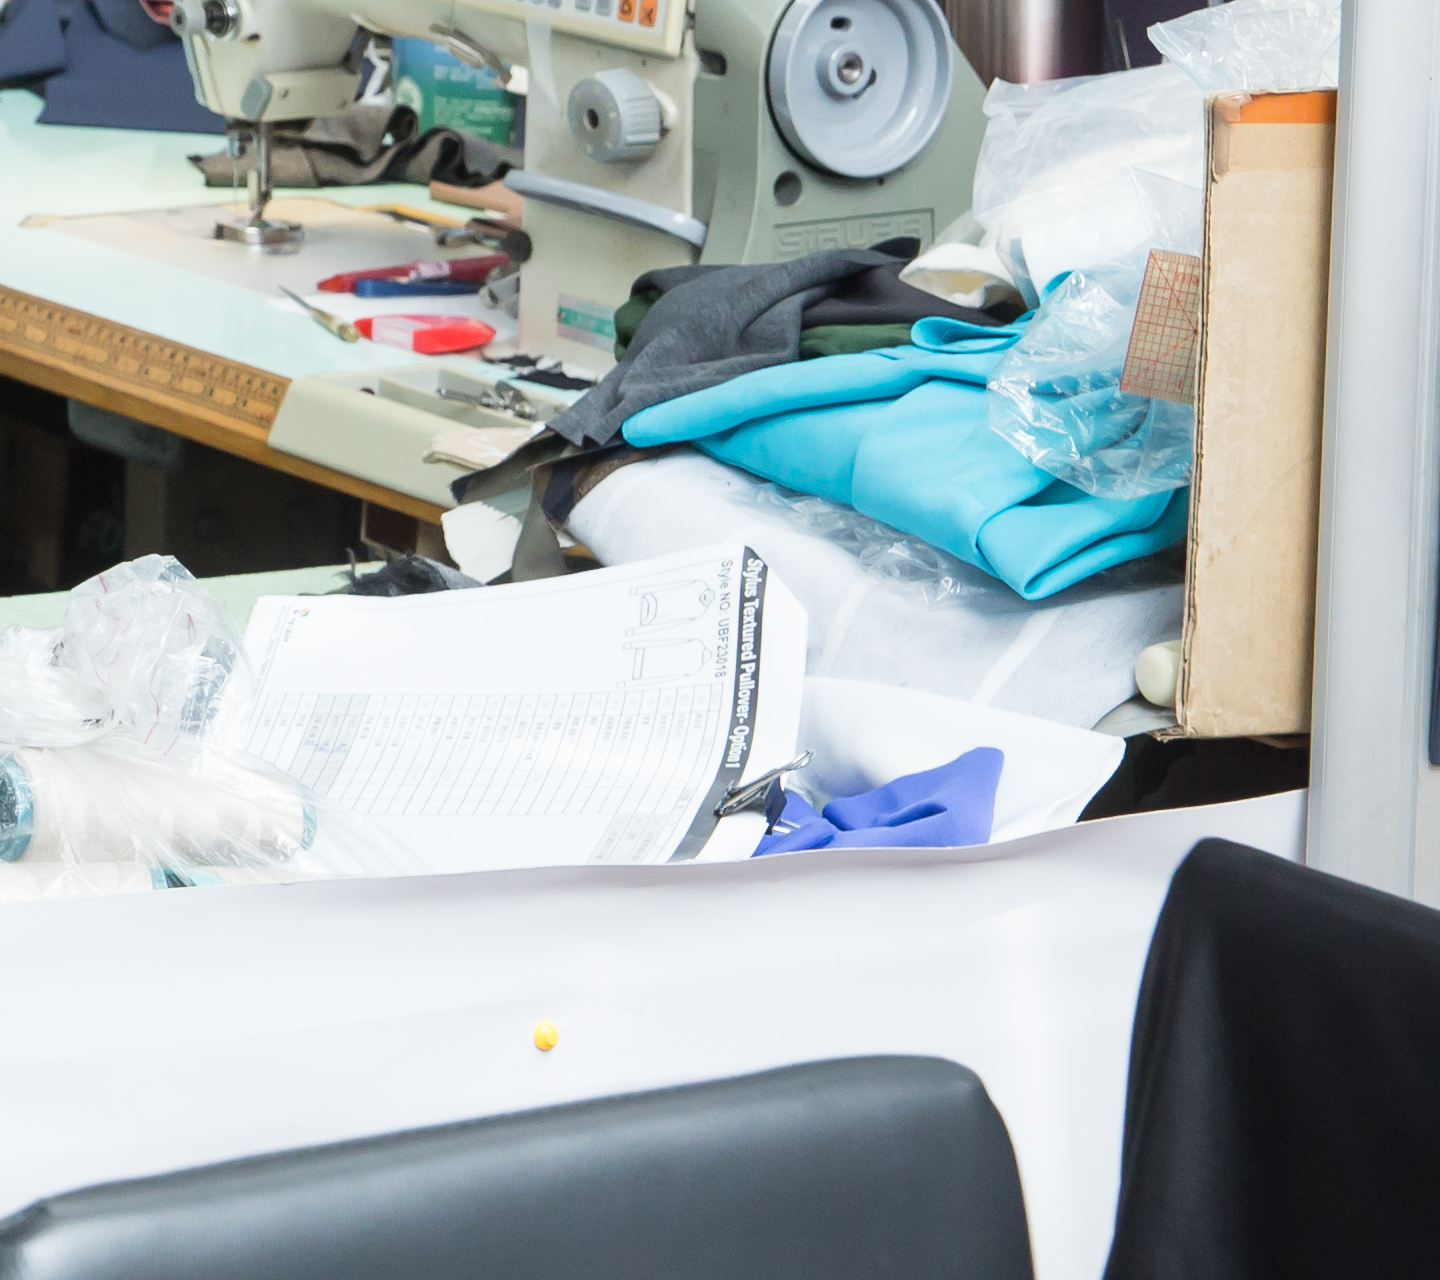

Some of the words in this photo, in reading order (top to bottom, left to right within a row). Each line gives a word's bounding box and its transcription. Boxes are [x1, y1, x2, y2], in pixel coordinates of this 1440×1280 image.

[718, 559, 734, 590] Style
[742, 557, 764, 598] Stylus
[714, 618, 730, 678] UBF23018
[740, 598, 759, 661] Textured
